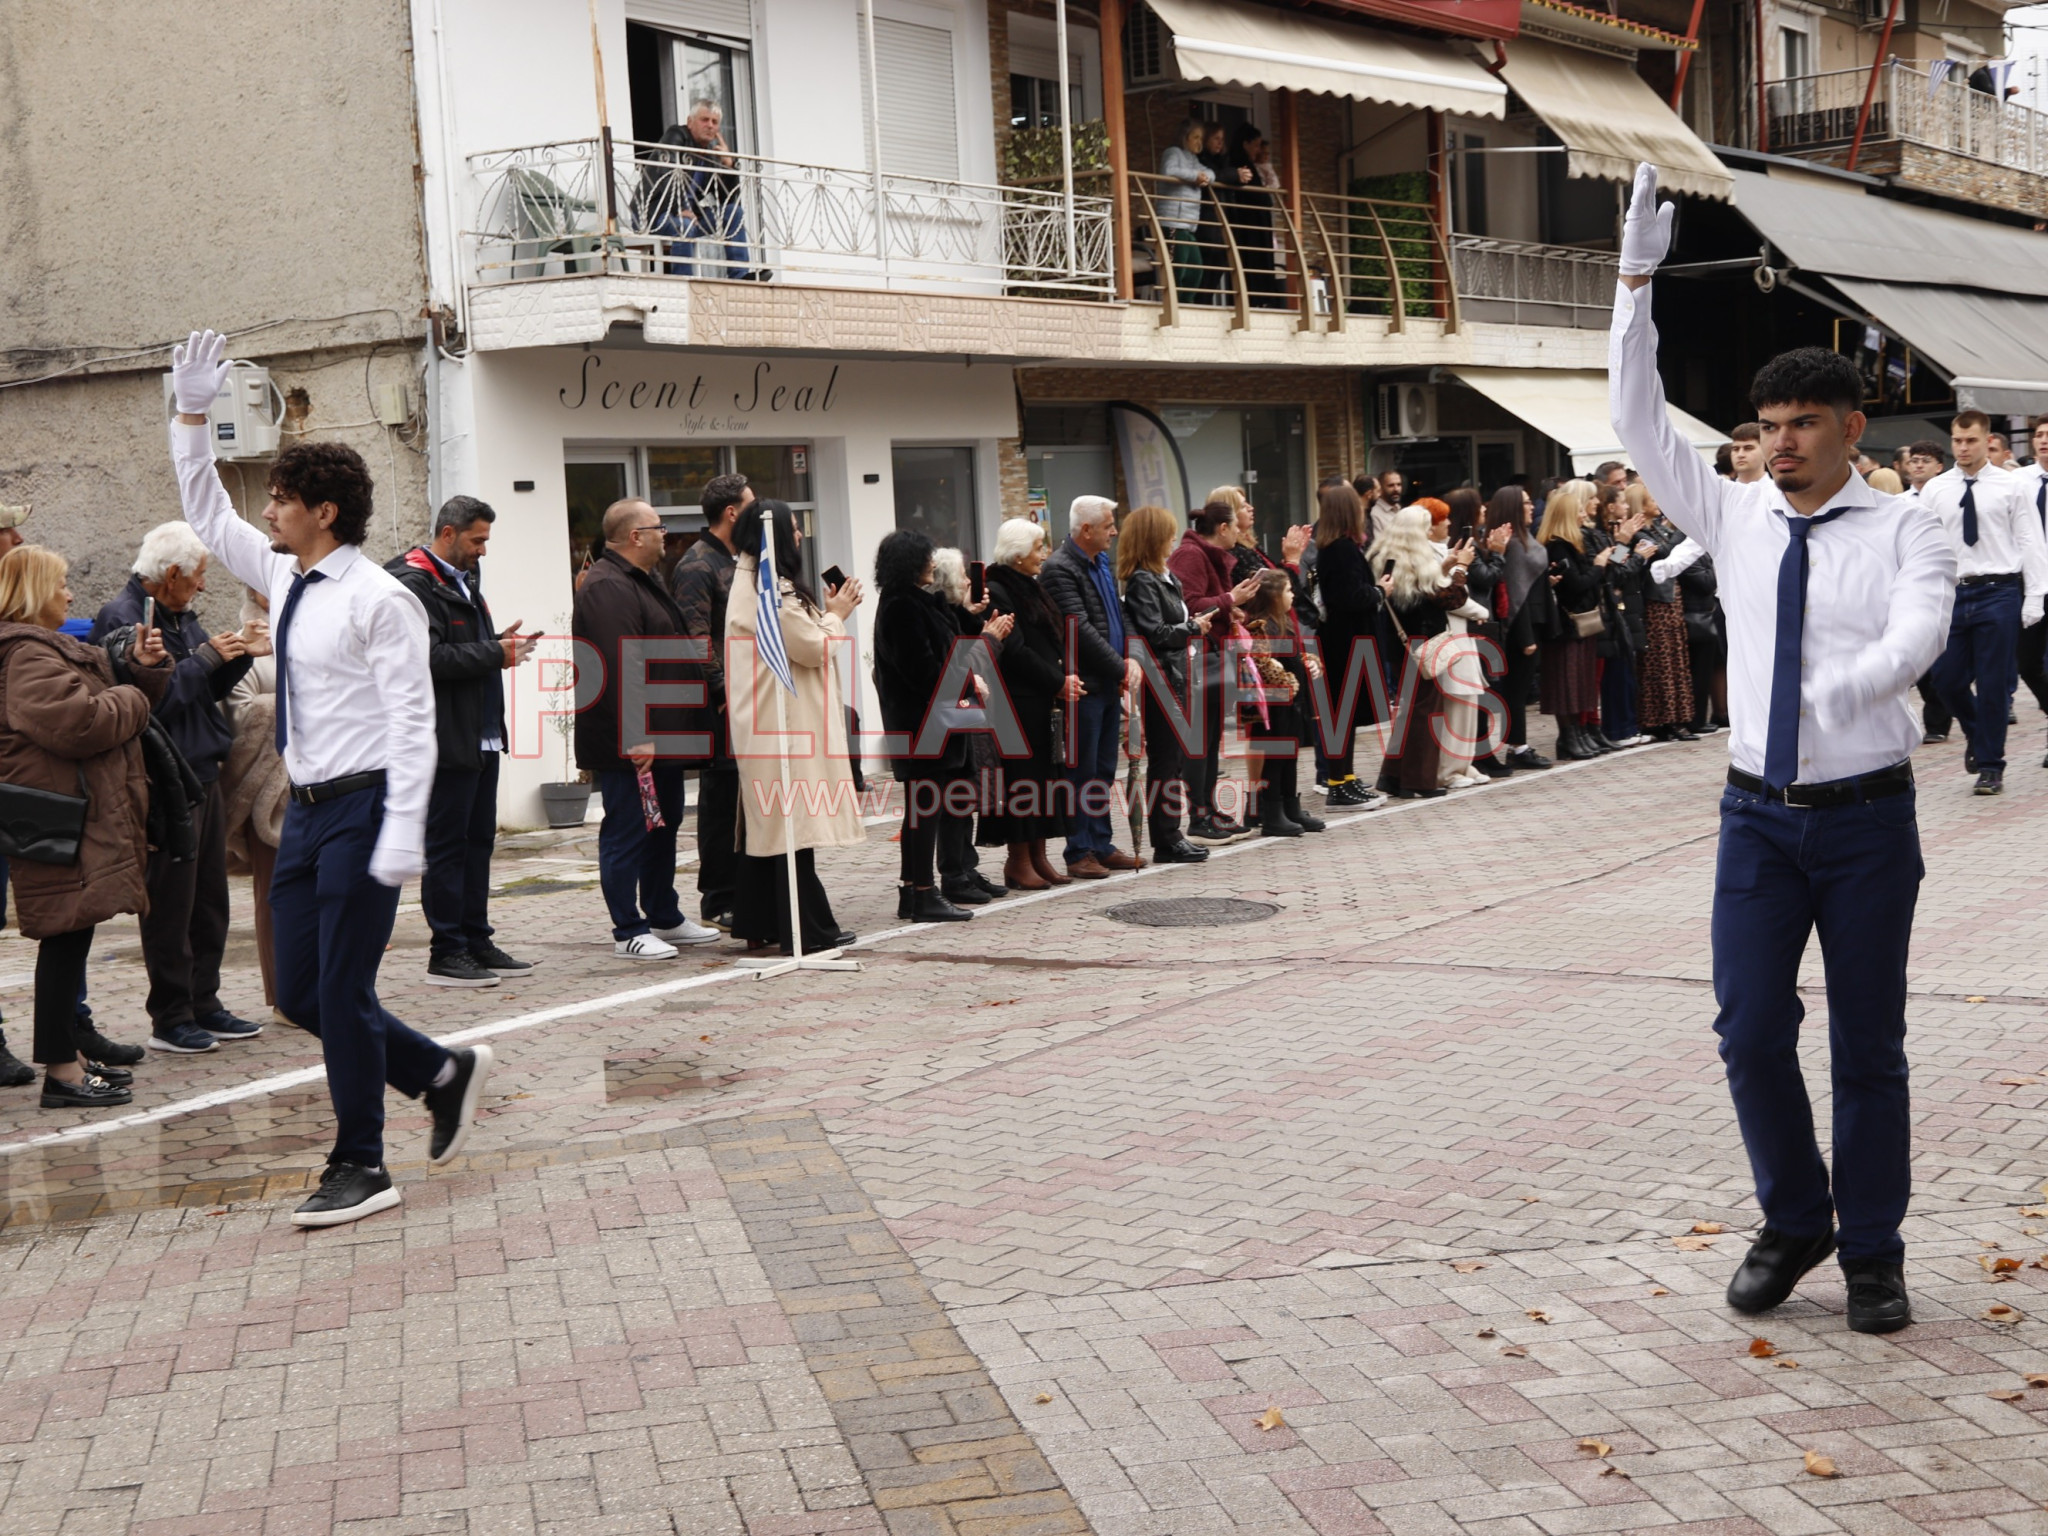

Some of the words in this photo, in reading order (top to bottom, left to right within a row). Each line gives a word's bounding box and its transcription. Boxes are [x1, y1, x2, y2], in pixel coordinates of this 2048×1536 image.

[560, 355, 708, 409] Scent
[734, 361, 839, 412] Seal
[680, 412, 706, 435] Style
[709, 417, 720, 431] &
[722, 415, 749, 431] Scent
